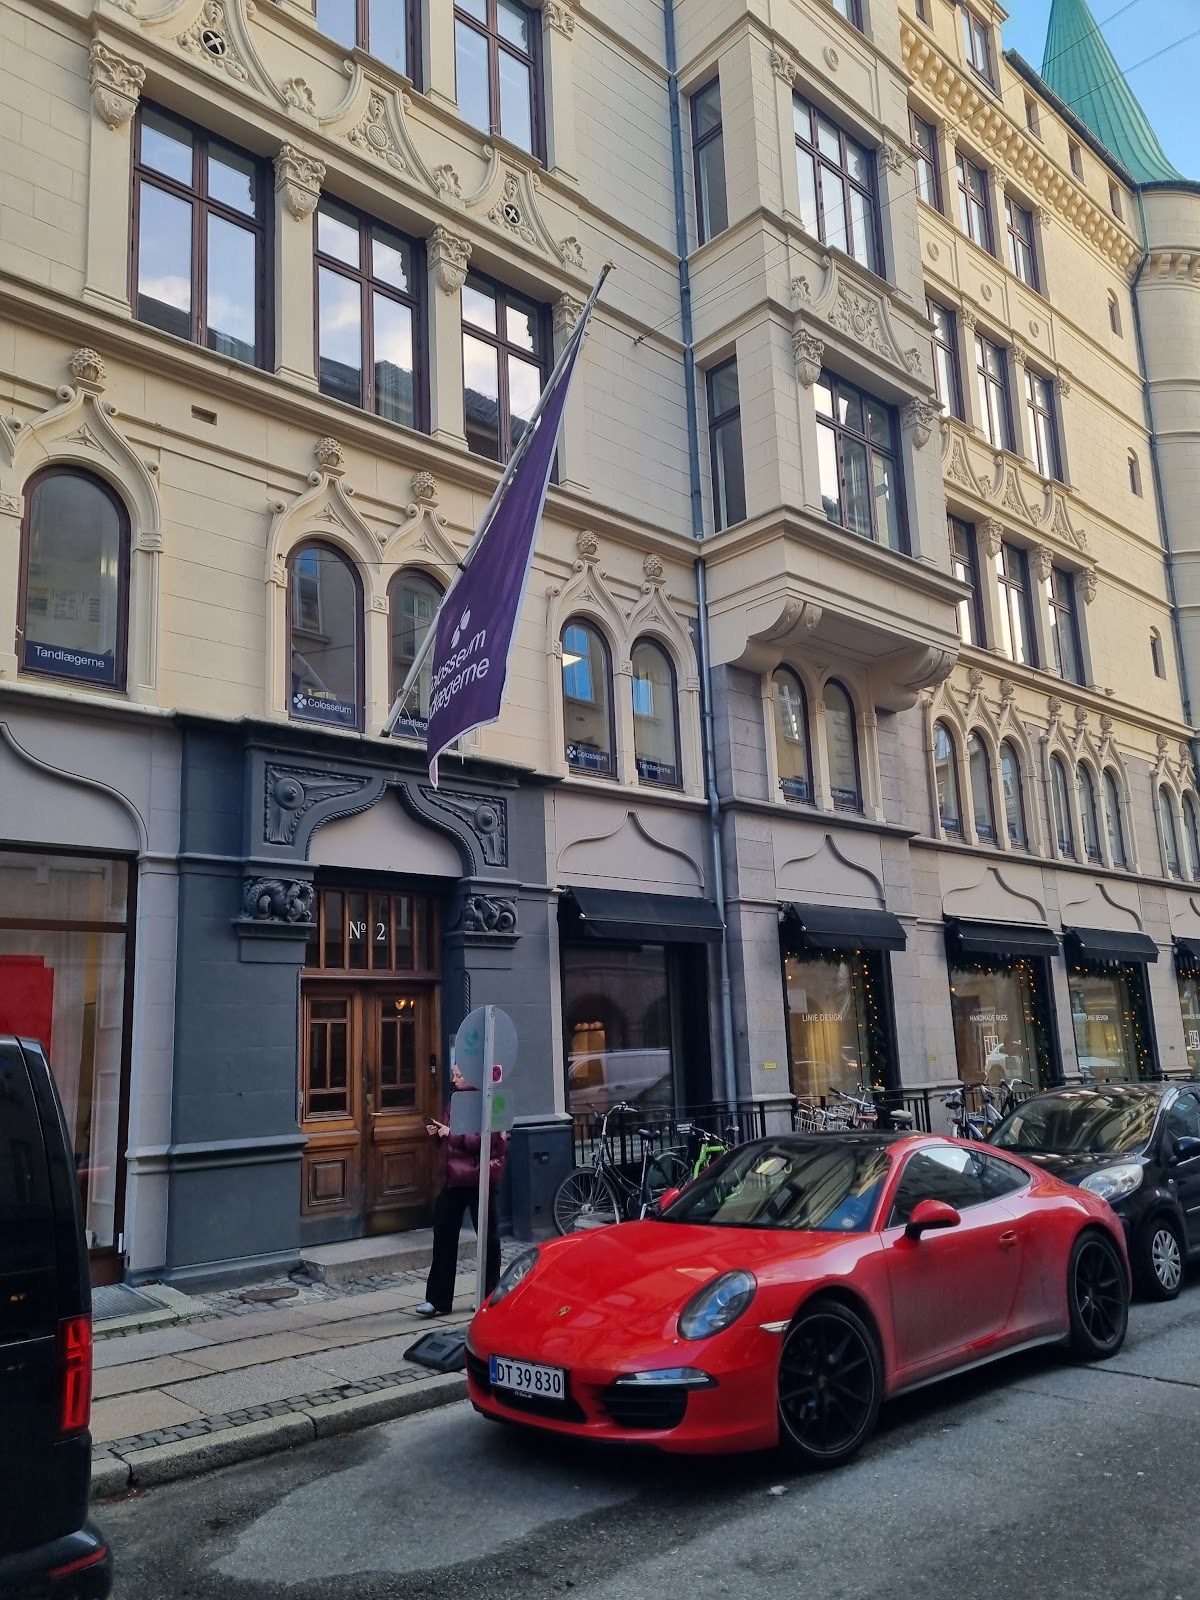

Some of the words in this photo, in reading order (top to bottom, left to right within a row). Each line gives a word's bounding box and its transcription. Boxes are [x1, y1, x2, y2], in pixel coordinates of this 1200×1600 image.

[34, 645, 105, 668] Tandlægerne
[429, 657, 490, 720] dlægerne
[307, 699, 352, 714] Colosseum
[397, 715, 428, 730] Tandlæg
[576, 749, 608, 762] Colosseum
[638, 761, 671, 775] Tandlægerne
[376, 922, 386, 940] 2
[802, 1013, 819, 1022] LINIE
[819, 1013, 843, 1022] DESIGN
[969, 1014, 995, 1022] HANDMADE
[995, 1014, 1008, 1022] RUGS
[497, 1362, 513, 1384] DT
[516, 1366, 532, 1389] 39
[534, 1370, 561, 1394] 830
